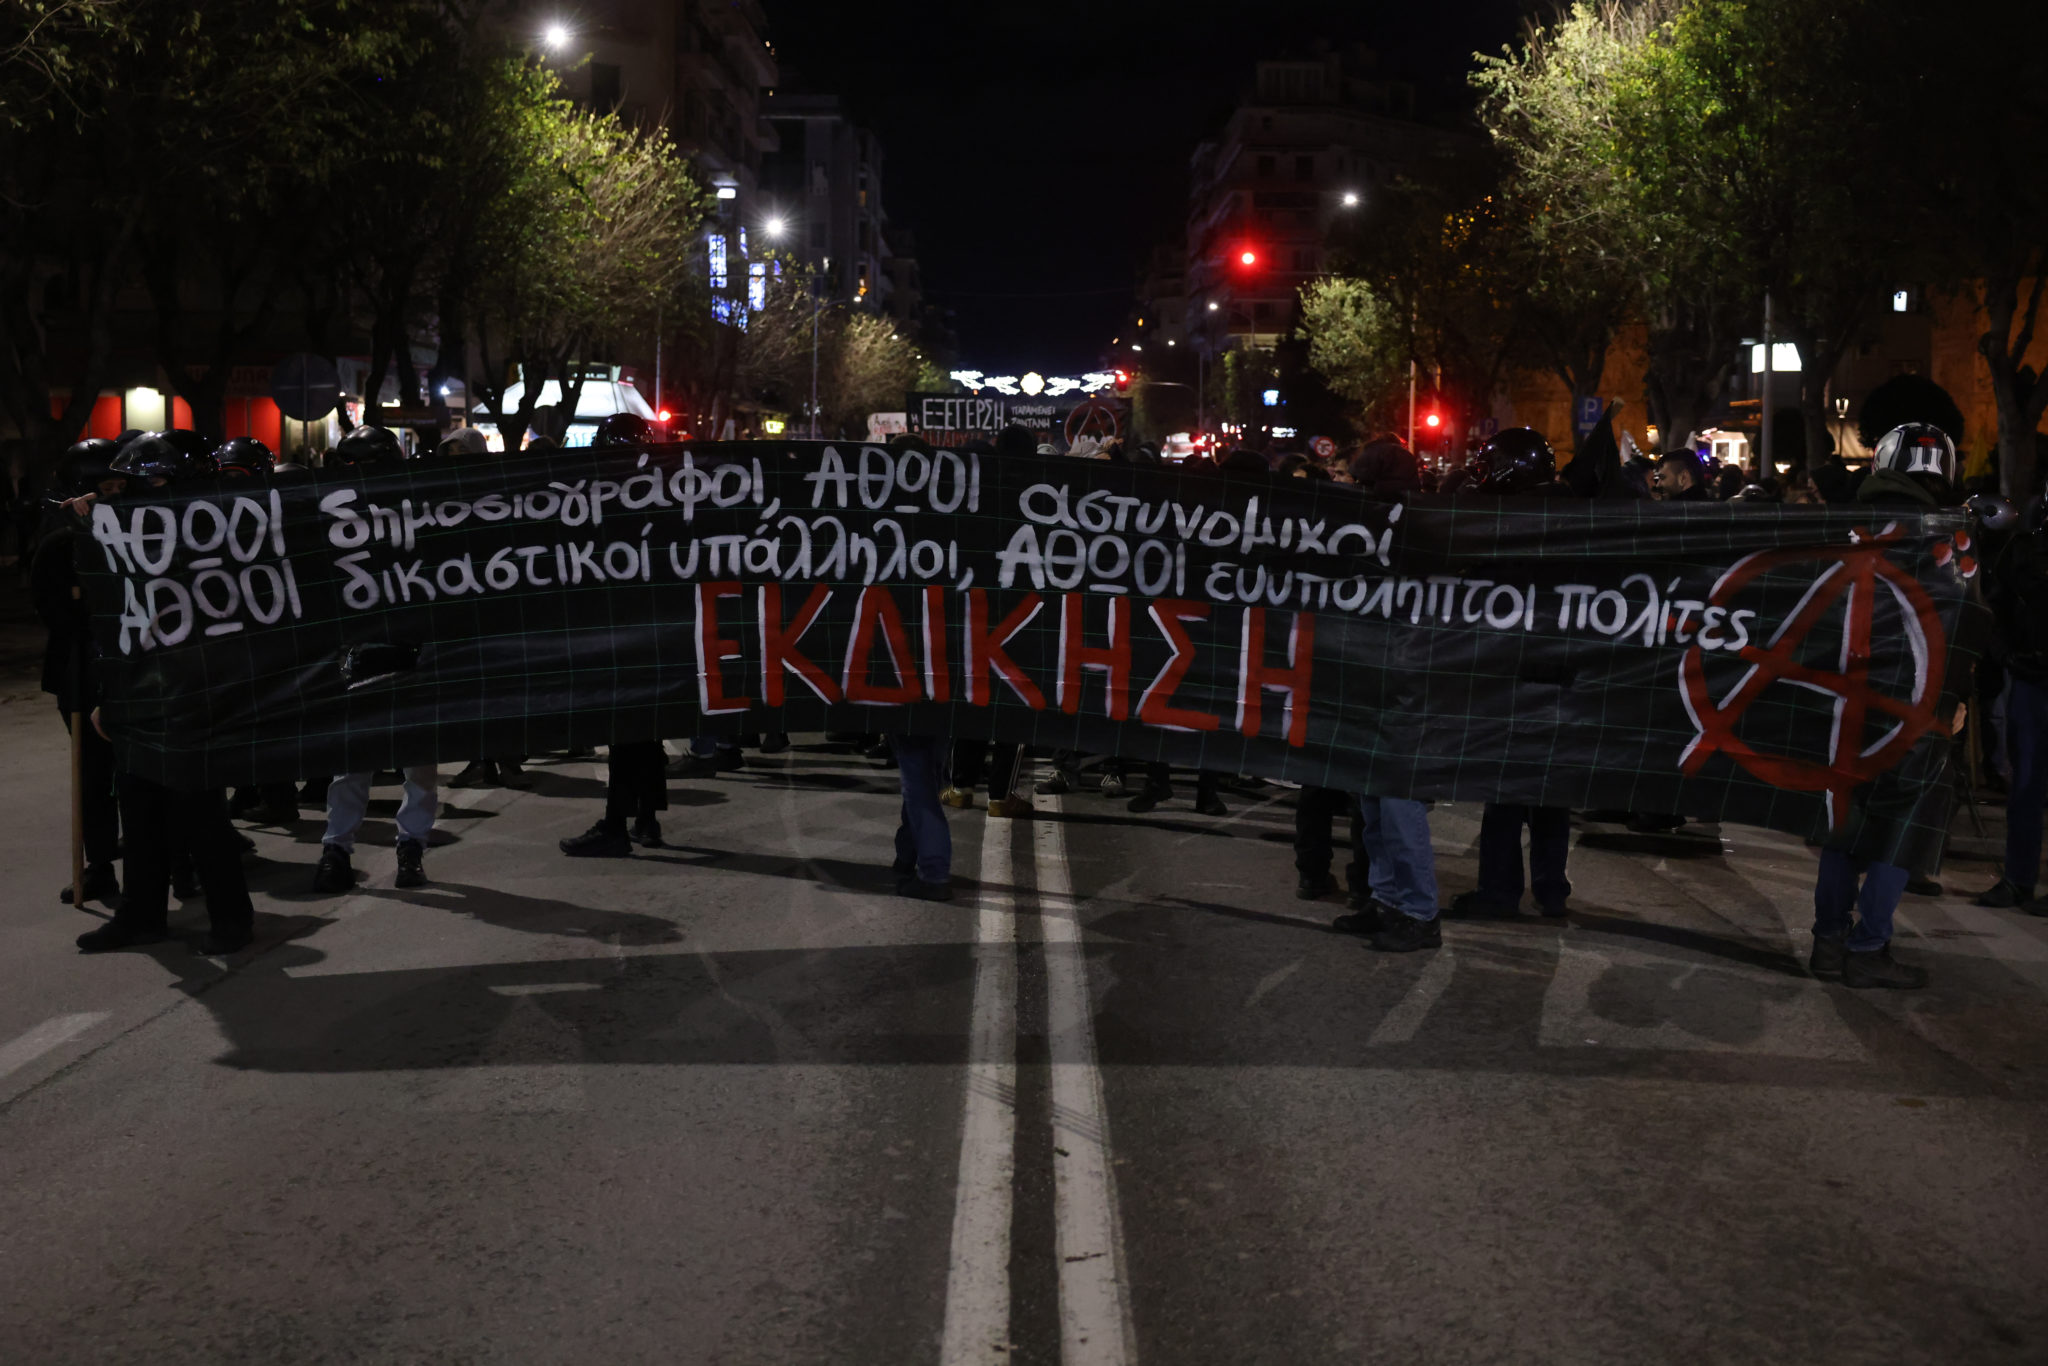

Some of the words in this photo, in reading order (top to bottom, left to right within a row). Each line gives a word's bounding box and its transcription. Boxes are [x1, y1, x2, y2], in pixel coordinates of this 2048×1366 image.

[922, 398, 1005, 430] ΕΞΕΓΕΡΣΗ
[1584, 398, 1598, 420] P
[1018, 483, 1403, 567] αστυνομικοί
[335, 522, 652, 611] δικαστικοί
[669, 515, 975, 591] υπάλληλοι,
[1554, 572, 1756, 651] πολίτες
[695, 581, 1315, 748] ΕΚΔΙΚΗΣΗ
